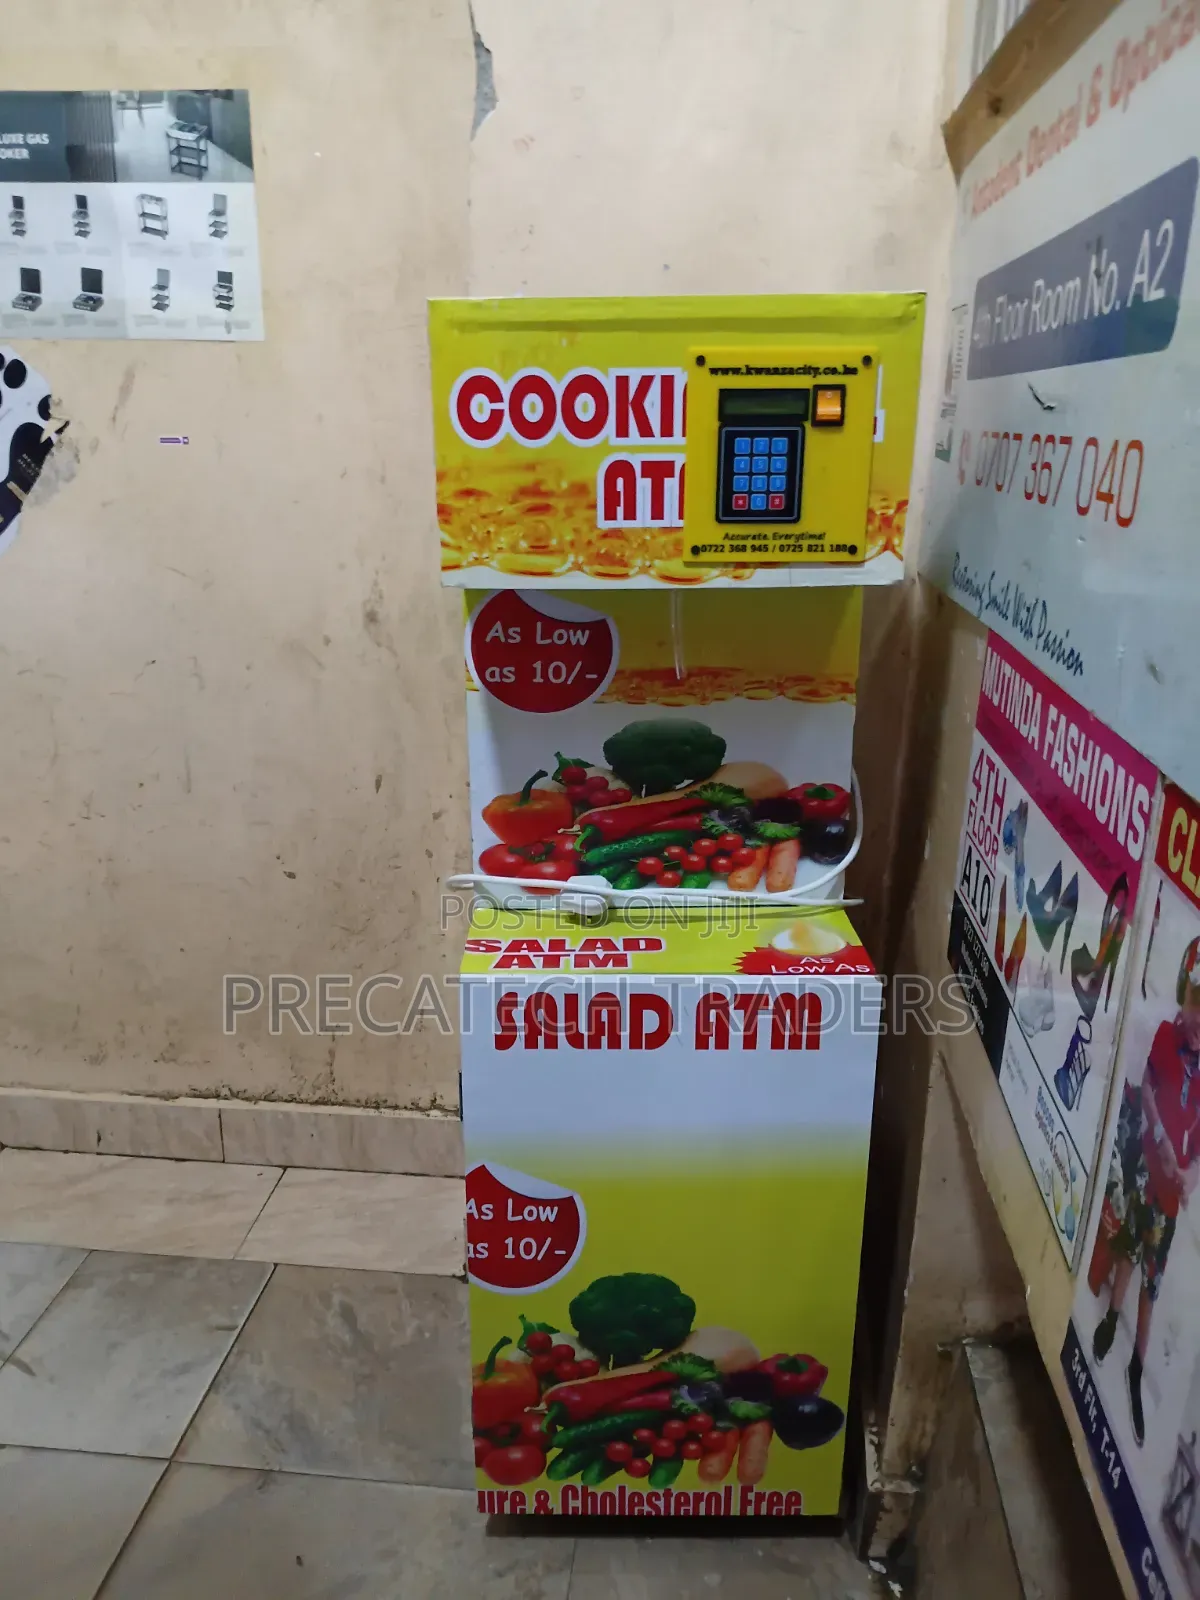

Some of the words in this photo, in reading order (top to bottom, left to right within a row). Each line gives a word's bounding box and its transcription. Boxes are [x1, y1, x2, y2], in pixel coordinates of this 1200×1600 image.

[992, 293, 1029, 344] Floor
[1028, 278, 1081, 336] Room
[1084, 248, 1121, 320] No.
[1127, 219, 1174, 307] A2
[457, 374, 687, 440] COOKI
[603, 460, 685, 521] AT
[975, 431, 1023, 493] 0707
[1024, 433, 1073, 507] 367
[1076, 436, 1144, 529] 040
[701, 544, 725, 553] 0722
[728, 544, 747, 553] 368
[750, 544, 769, 553] 945
[778, 544, 803, 553] 0725
[485, 620, 521, 644] As
[535, 621, 590, 646] Low
[485, 666, 516, 683] as
[532, 660, 598, 685] 10/-
[981, 647, 1043, 751] MUTINDA
[1043, 704, 1150, 862] FASHIONS
[972, 748, 1007, 835] 4TH
[967, 798, 998, 871] FLOOR
[464, 938, 663, 953] SALAD
[493, 953, 629, 969] ATM
[771, 965, 826, 974] Low
[834, 964, 871, 973] As
[799, 956, 834, 964] As
[494, 992, 674, 1050] SALAD
[694, 992, 822, 1050] ATM
[507, 1198, 559, 1222] Low
[504, 1236, 567, 1260] 10/-
[534, 1490, 554, 1514] &
[561, 1485, 732, 1515] Cholesterol
[740, 1485, 802, 1515] Free
